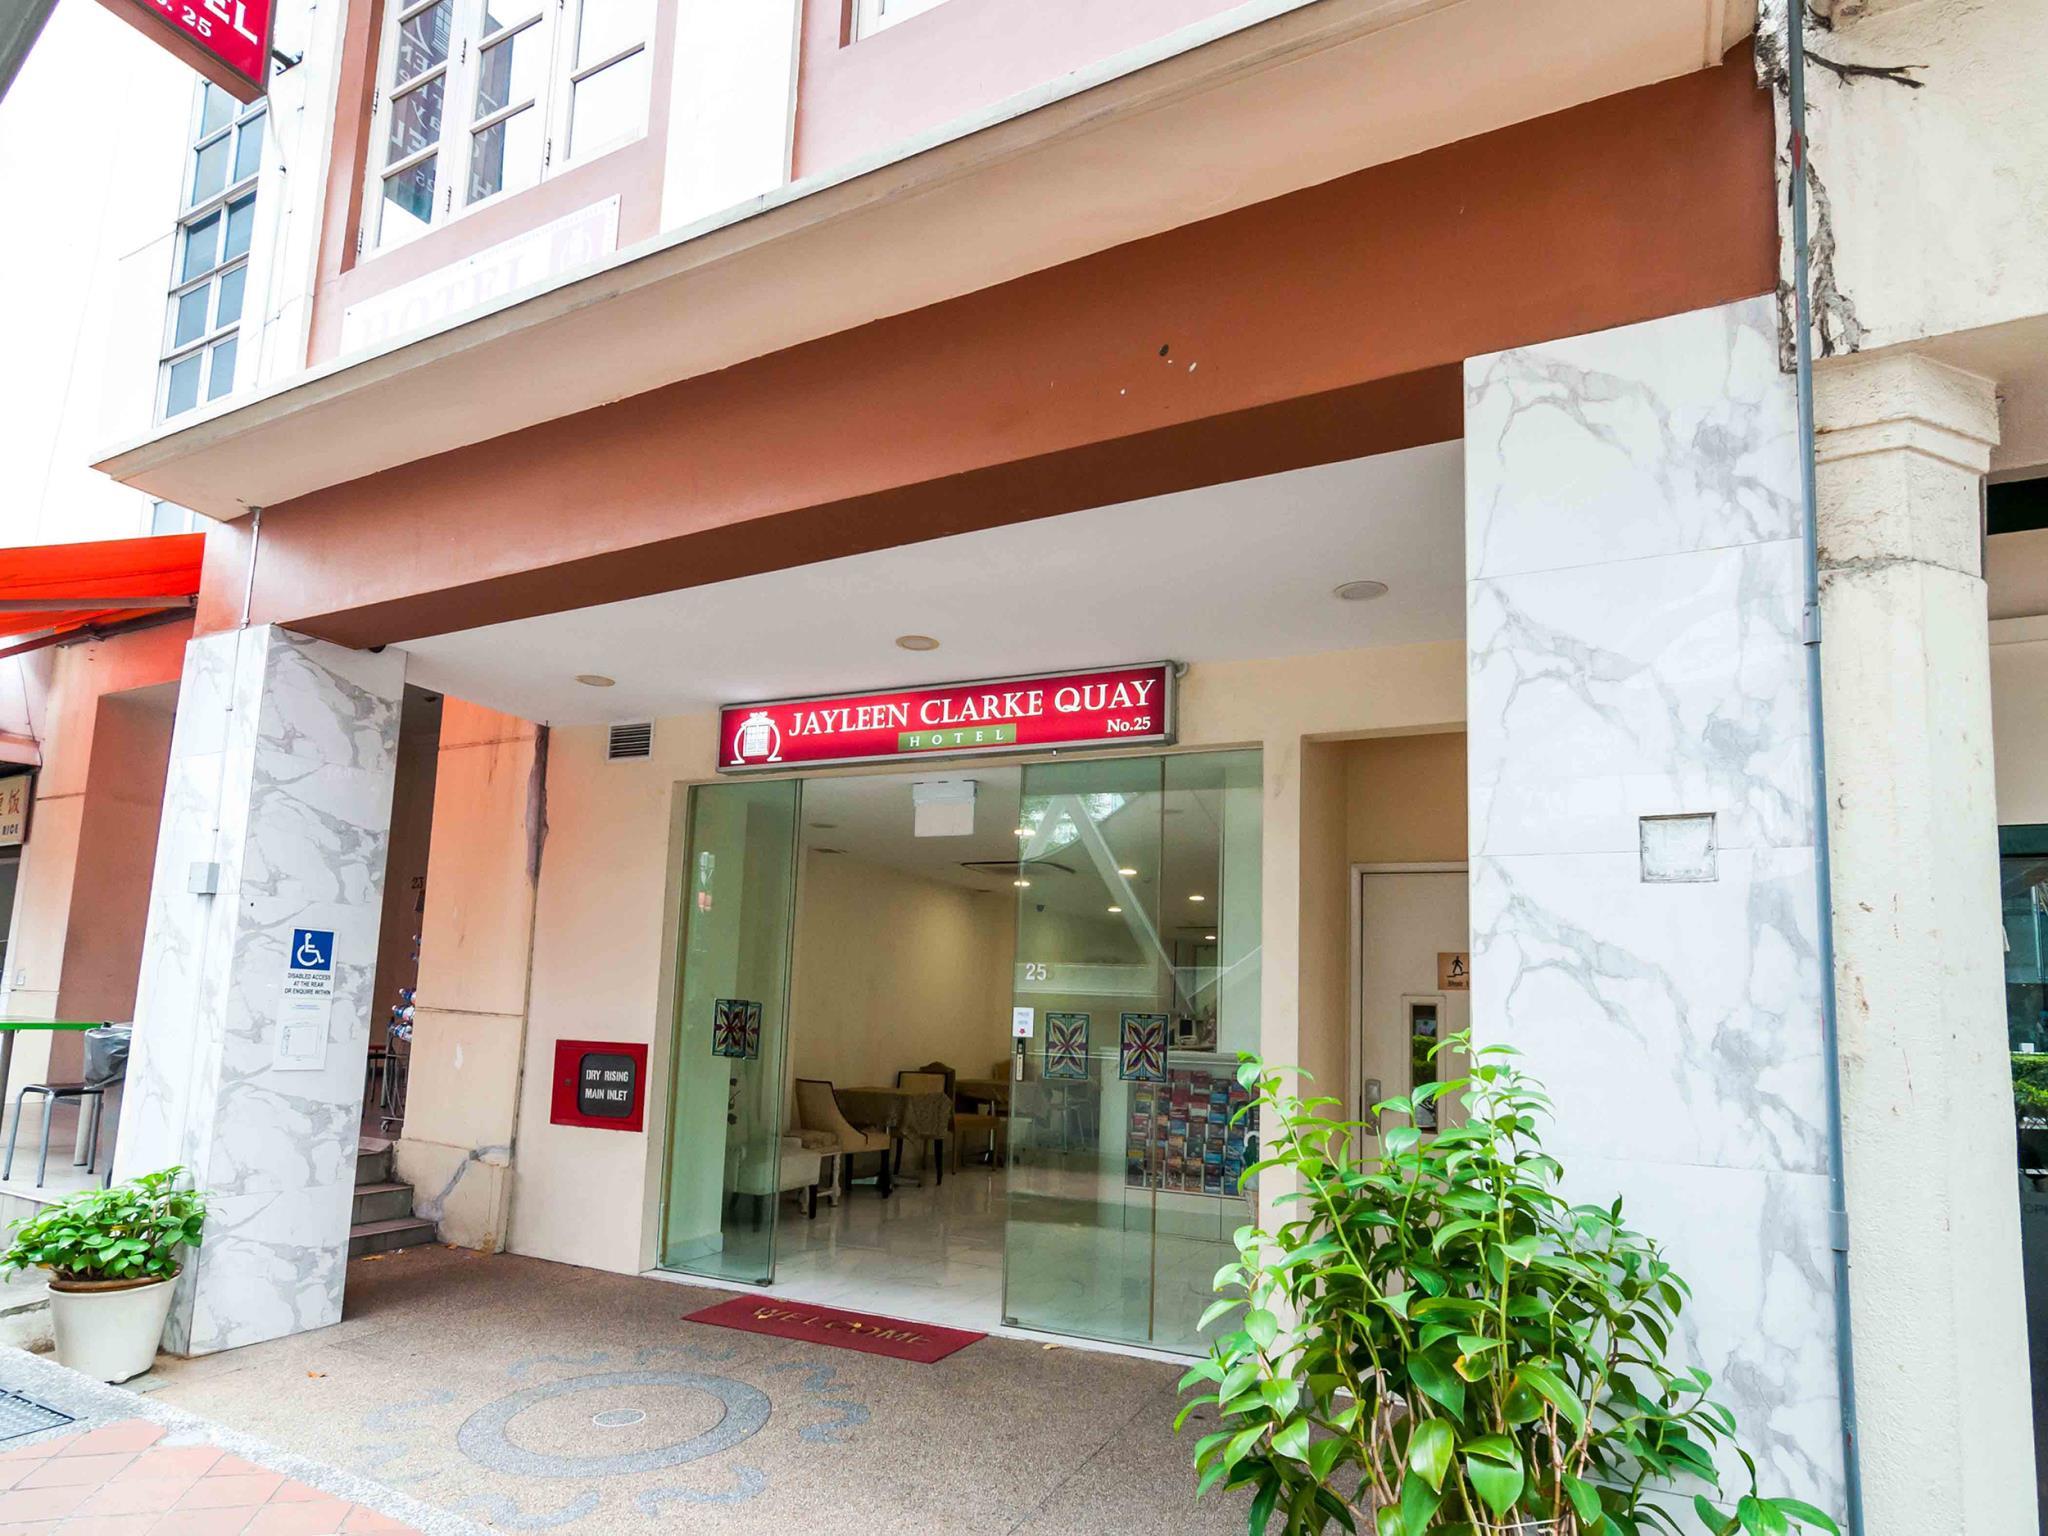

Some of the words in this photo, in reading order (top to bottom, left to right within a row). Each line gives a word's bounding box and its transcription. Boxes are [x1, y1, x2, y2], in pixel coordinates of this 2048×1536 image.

[182, 5, 212, 37] 25
[788, 702, 911, 737] JAYLEEN
[920, 689, 1044, 725] CLARKE
[1054, 679, 1157, 713] QUAY
[1106, 716, 1151, 733] No.25
[909, 729, 1004, 747] HOTEL
[312, 973, 331, 981] ACCESS
[1025, 962, 1047, 981] 25
[586, 1069, 602, 1081] DRY
[604, 1070, 629, 1082] RISING
[585, 1088, 605, 1100] MAIN
[607, 1089, 628, 1102] INLET
